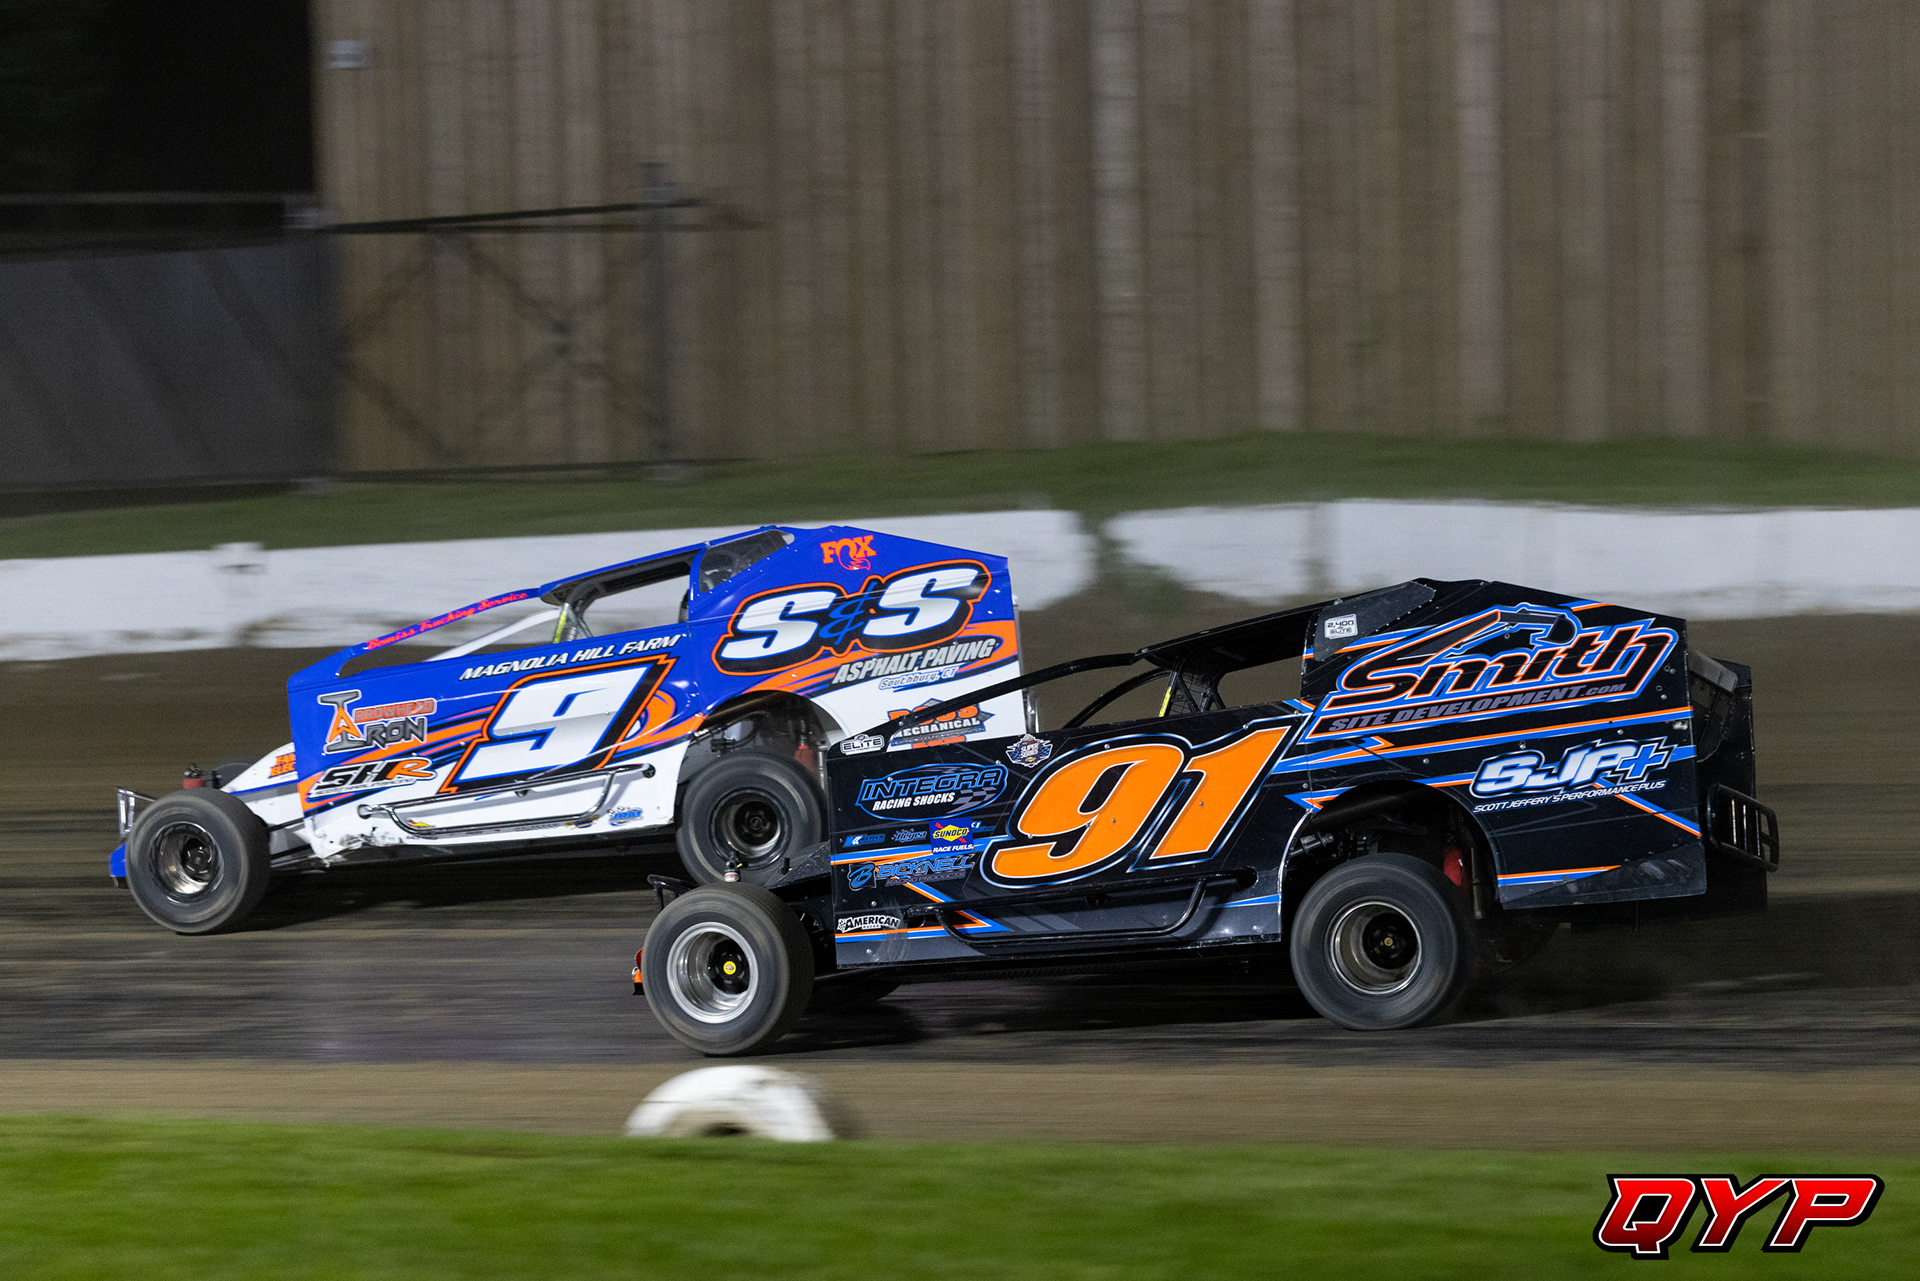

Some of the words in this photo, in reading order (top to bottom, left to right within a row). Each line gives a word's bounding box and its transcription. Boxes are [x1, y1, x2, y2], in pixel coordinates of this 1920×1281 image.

[820, 534, 877, 570] FOX
[477, 593, 528, 611] Service
[458, 652, 568, 681] MAGNOLIA
[570, 643, 616, 664] HILL
[618, 634, 682, 656] FARM
[832, 650, 922, 684] ASPHALT
[920, 638, 996, 668] PAVING
[1342, 612, 1678, 698] Smith
[942, 667, 956, 679] CT
[453, 664, 650, 782] 9
[1328, 712, 1389, 732] SITE
[843, 738, 882, 751] ELITE
[861, 769, 1003, 801] INTEGRA
[1473, 801, 1508, 813] SCOTT
[1557, 784, 1639, 801] PERFORMANCE
[1636, 780, 1667, 793] PLUS
[872, 797, 912, 811] RACING
[913, 792, 955, 807] SHOCKS
[992, 725, 1291, 879] 91
[934, 828, 969, 839] SUNOCO
[877, 855, 974, 878] BICKNELL
[844, 916, 899, 931] AMERICAN
